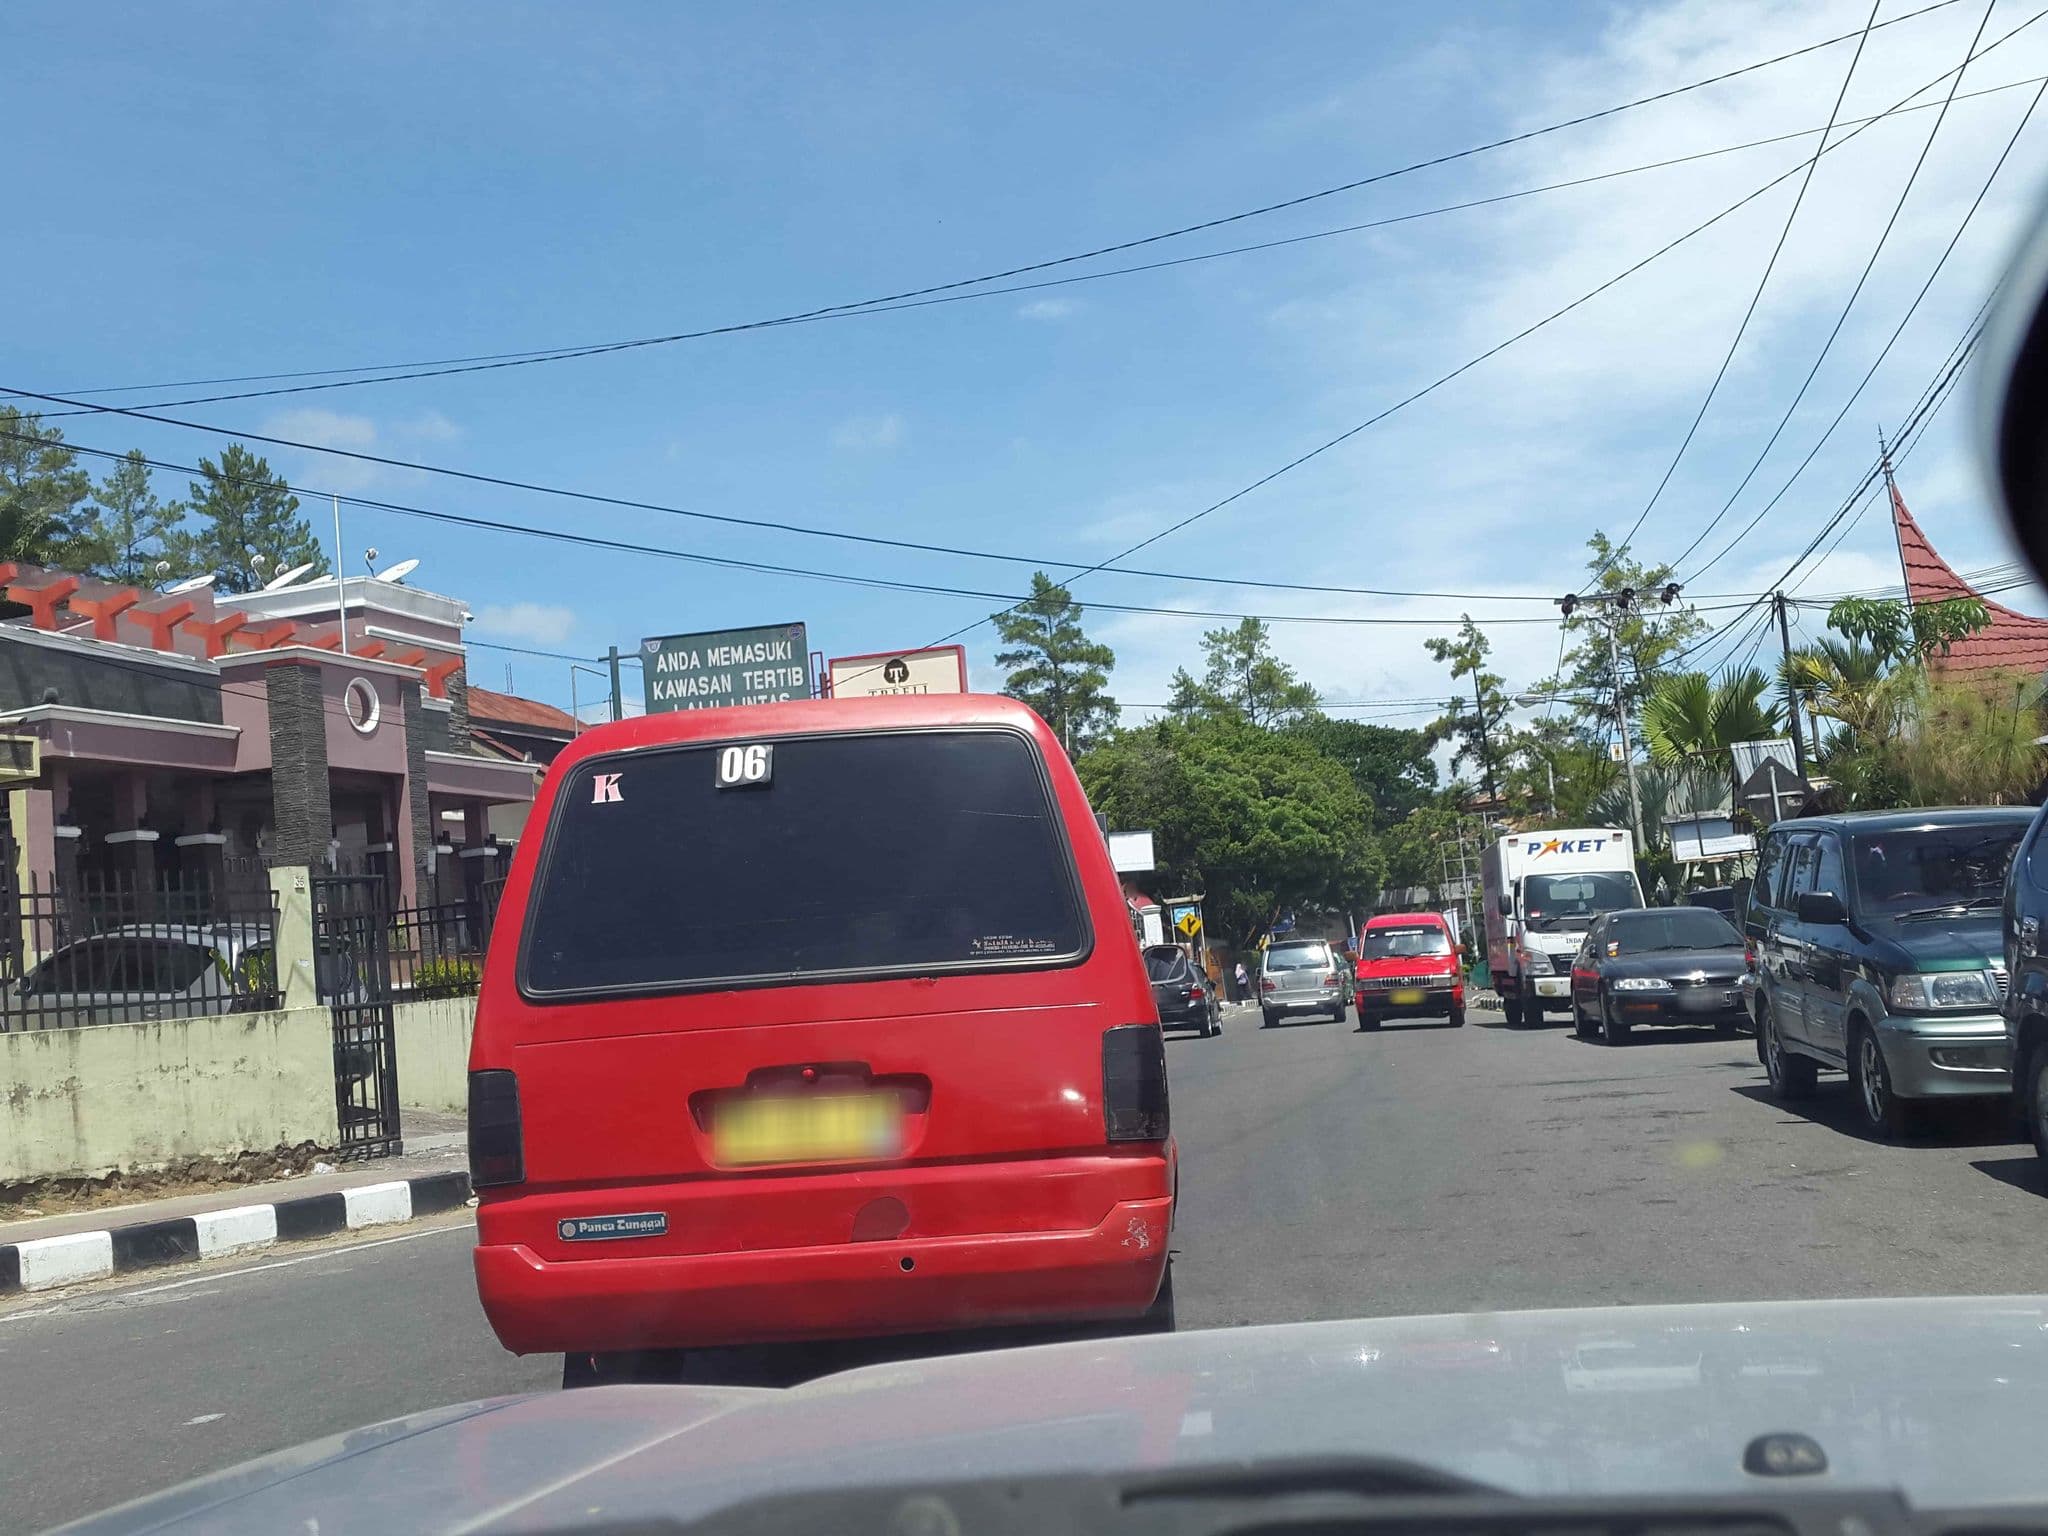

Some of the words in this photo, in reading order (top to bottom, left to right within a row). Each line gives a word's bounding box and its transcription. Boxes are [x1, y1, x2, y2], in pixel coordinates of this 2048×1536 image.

[656, 650, 701, 673] ANDA
[707, 640, 792, 667] MEMASUKI
[652, 673, 732, 700] KAWASAN
[742, 666, 804, 690] TERTIB
[720, 745, 767, 783] 06
[591, 773, 625, 803] K
[578, 1222, 615, 1233] Panca
